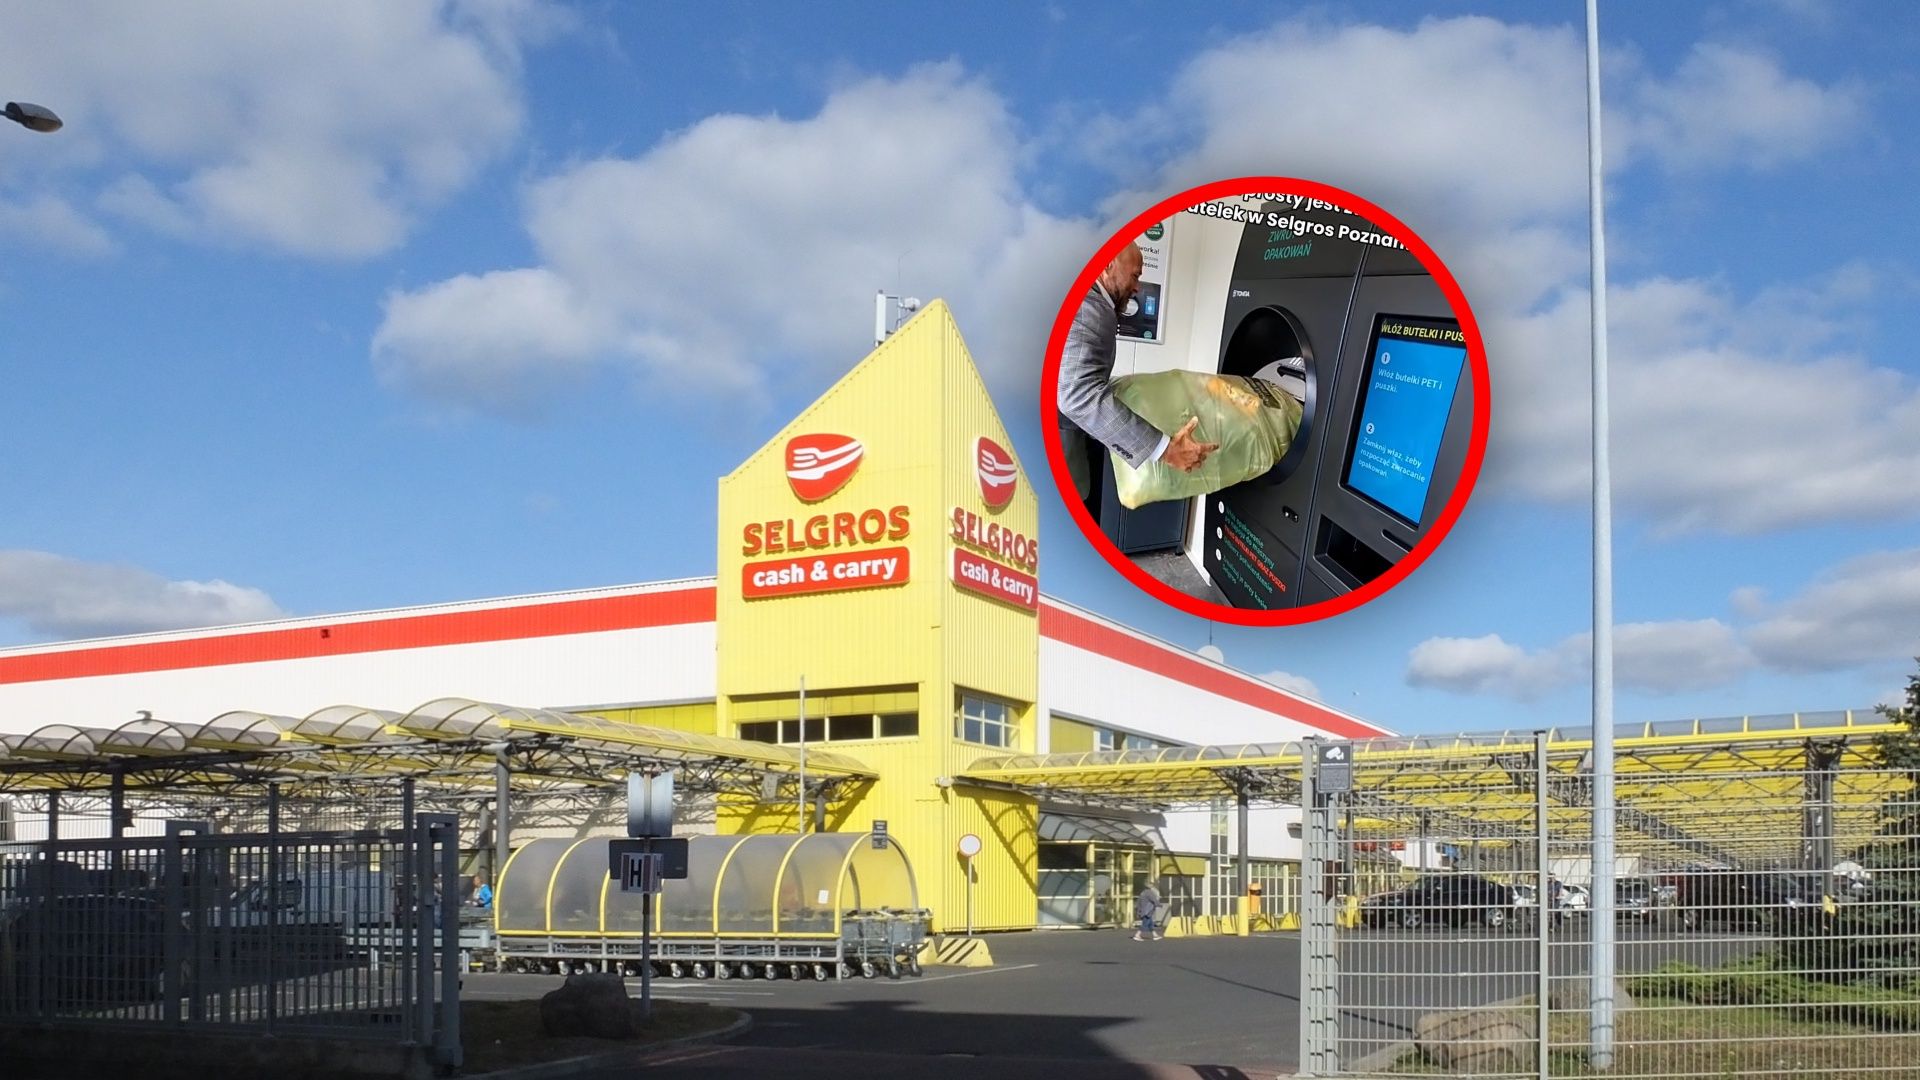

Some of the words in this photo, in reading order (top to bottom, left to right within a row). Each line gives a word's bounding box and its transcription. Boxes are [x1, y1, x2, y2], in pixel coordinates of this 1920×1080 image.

[1264, 240, 1312, 261] OPAKOWAŃ
[1403, 326, 1438, 340] BUTELKI
[1439, 329, 1444, 340] I
[1444, 330, 1466, 342] PUS
[1395, 372, 1420, 385] butelki
[1421, 377, 1438, 389] PET
[743, 505, 910, 555] SELGROS
[953, 507, 1038, 567] SELGROS
[753, 563, 805, 587] cash
[810, 560, 828, 581] &
[833, 557, 898, 580] carry
[960, 560, 989, 584] cash
[991, 568, 1001, 588] &
[1002, 576, 1033, 604] carry
